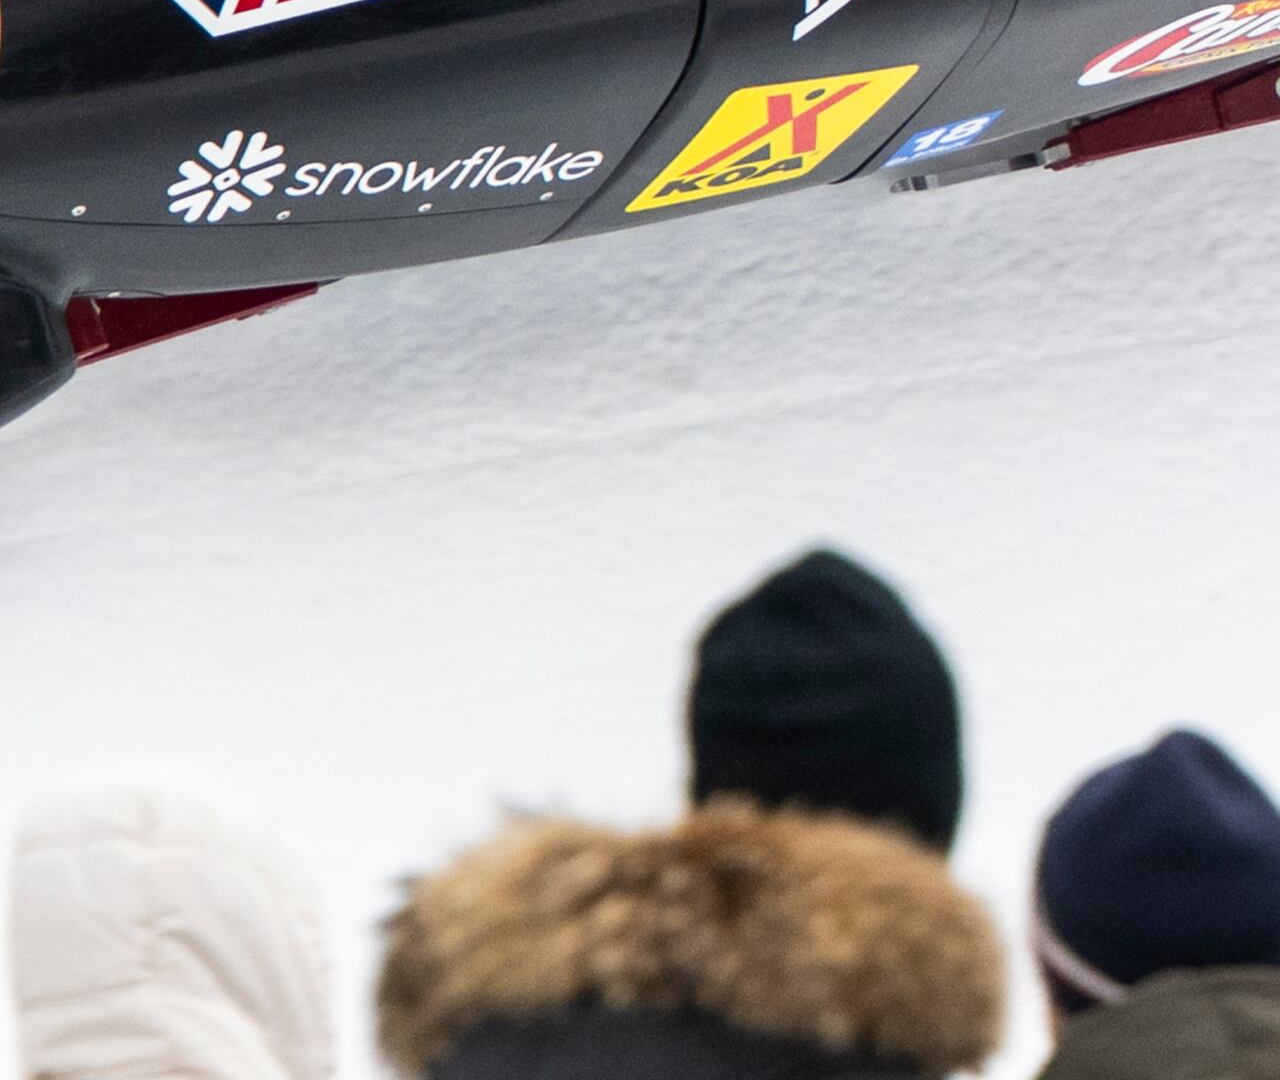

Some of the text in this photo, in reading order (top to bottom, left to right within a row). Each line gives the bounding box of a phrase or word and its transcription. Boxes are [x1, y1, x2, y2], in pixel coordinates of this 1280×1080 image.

[913, 117, 991, 152] 18
[286, 141, 603, 198] snowflake
[652, 157, 805, 199] KOA
